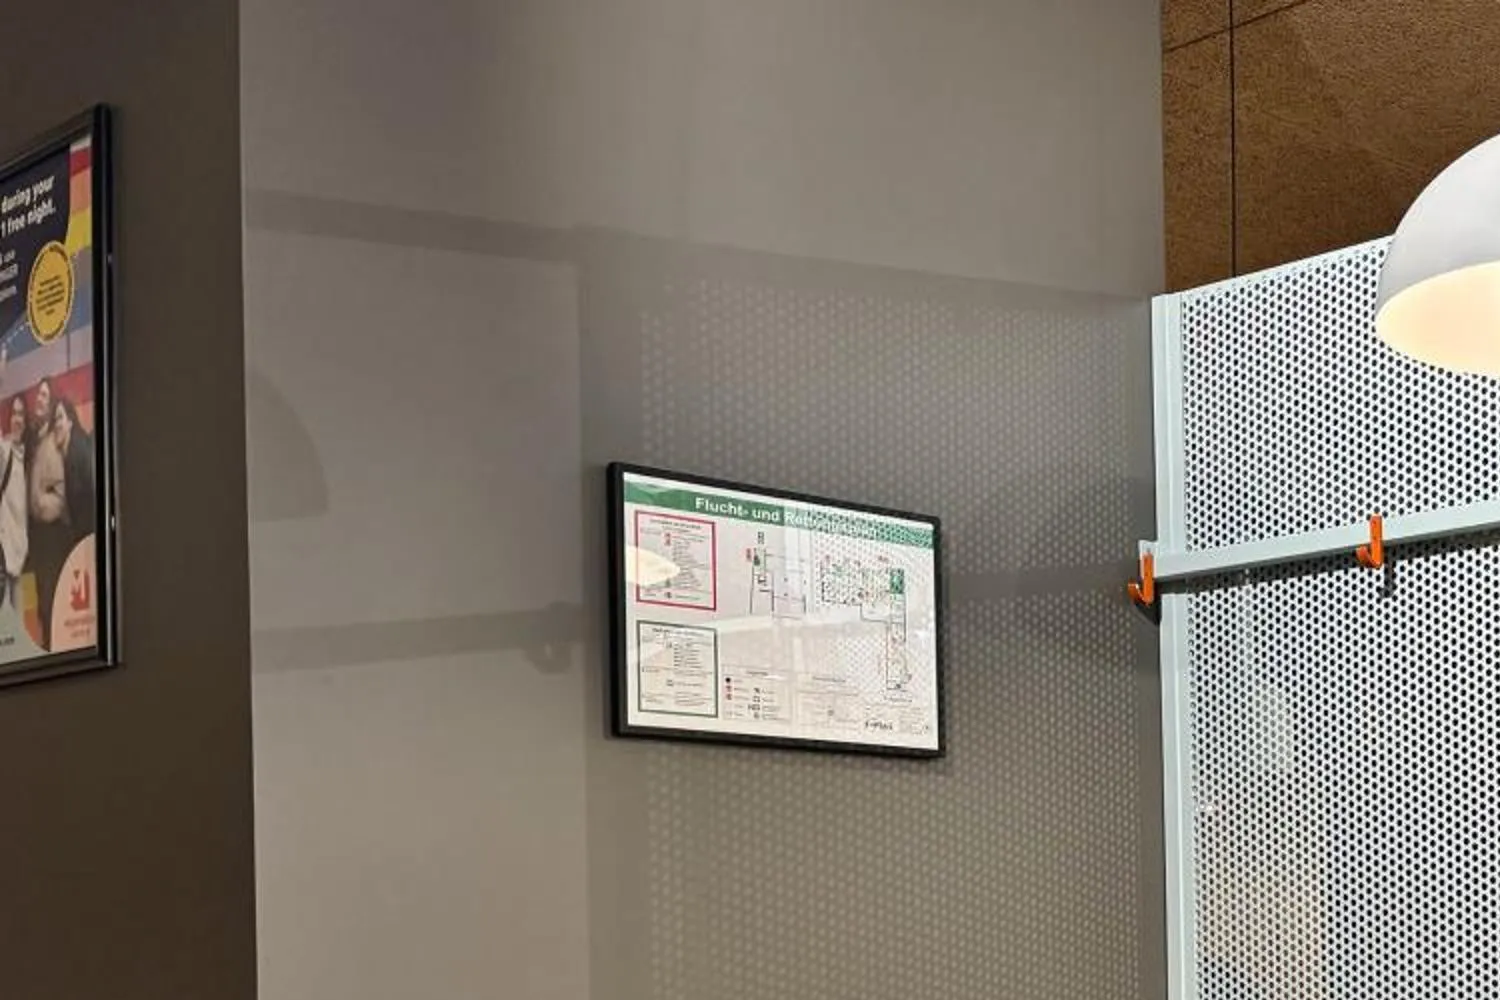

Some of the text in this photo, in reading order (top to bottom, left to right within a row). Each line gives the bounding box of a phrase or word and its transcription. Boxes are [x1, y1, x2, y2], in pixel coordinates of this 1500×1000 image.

[32, 175, 55, 202] your
[694, 496, 780, 522] Flucht- und
